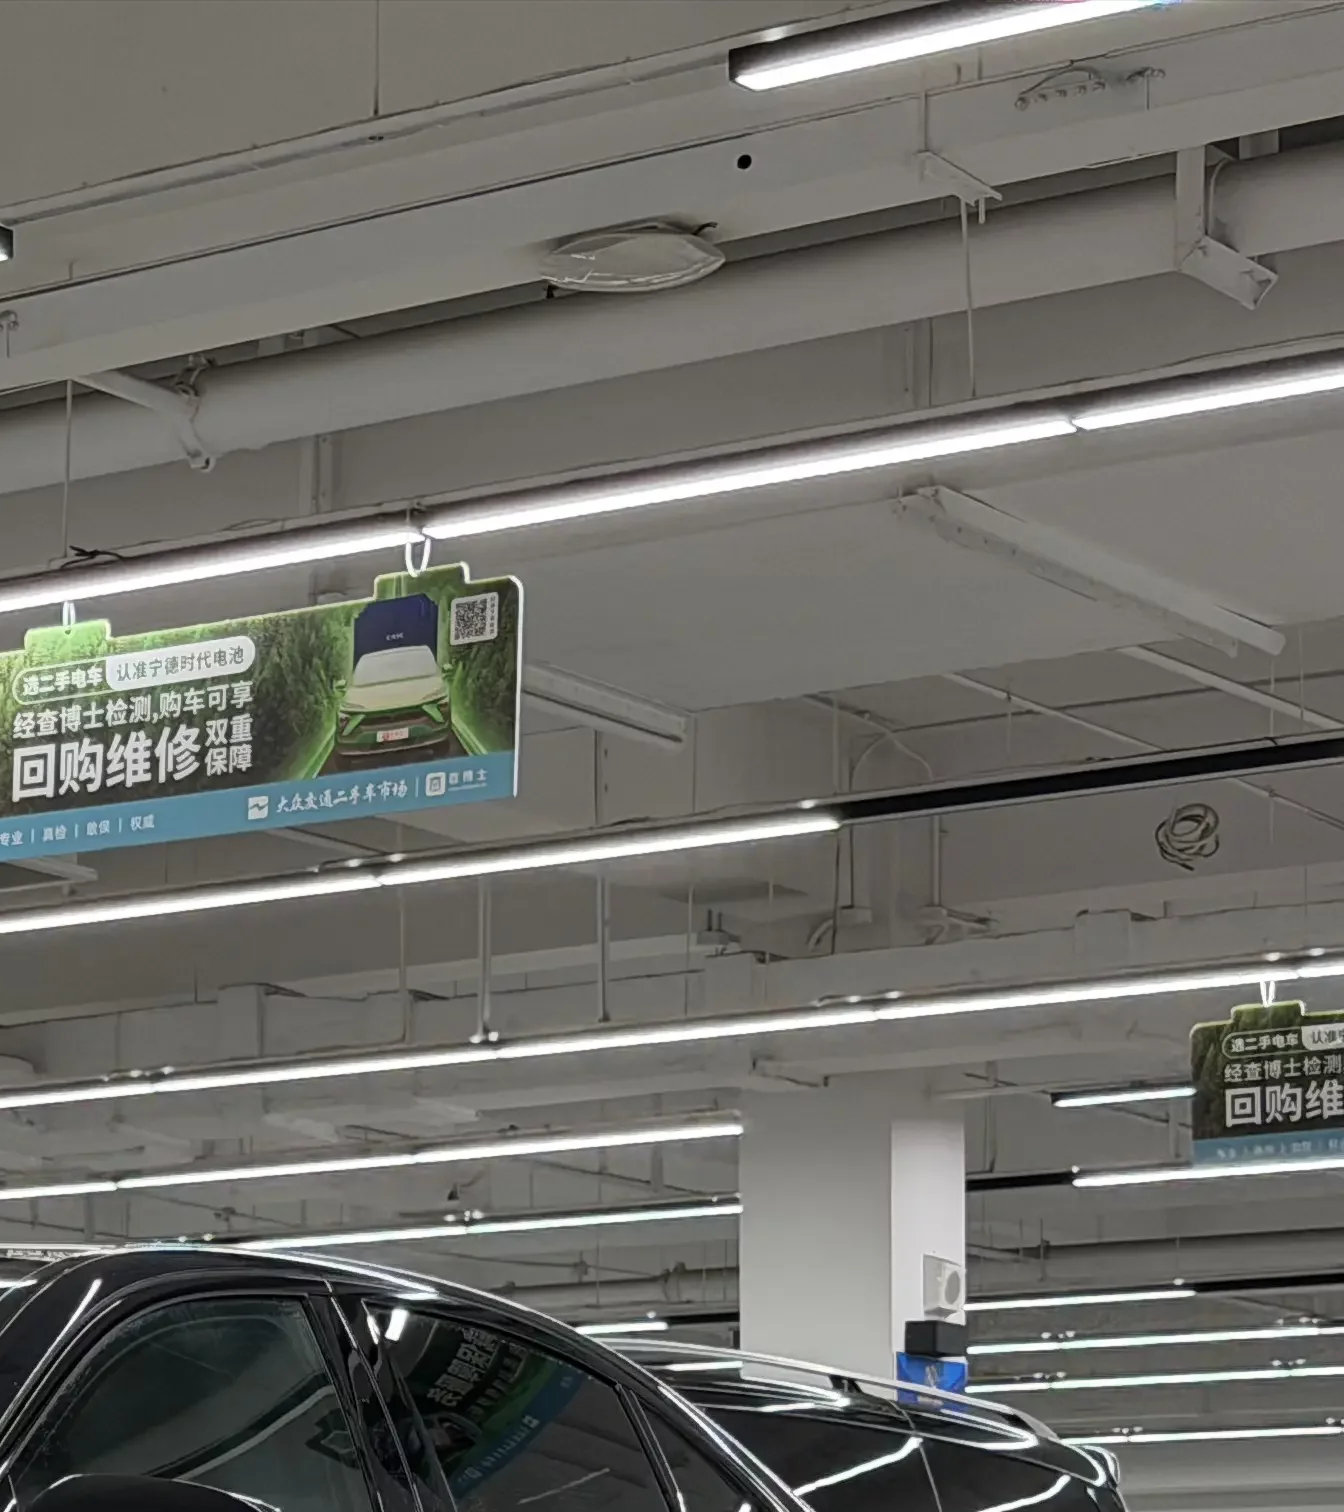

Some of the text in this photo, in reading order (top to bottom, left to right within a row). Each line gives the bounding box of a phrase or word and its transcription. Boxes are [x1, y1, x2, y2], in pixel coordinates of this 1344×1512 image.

[22, 645, 245, 696] 选二手电车 认准宁德时代电池
[12, 680, 254, 739] 经查博士检测,购车可享
[205, 713, 253, 747] 双重
[12, 724, 201, 803] 回购维修
[205, 744, 253, 777] 保障
[276, 779, 408, 813] 大众交通二手车市场
[0, 830, 24, 847] 专业
[130, 814, 155, 832] 权威
[1225, 1079, 1344, 1128] 回购维
